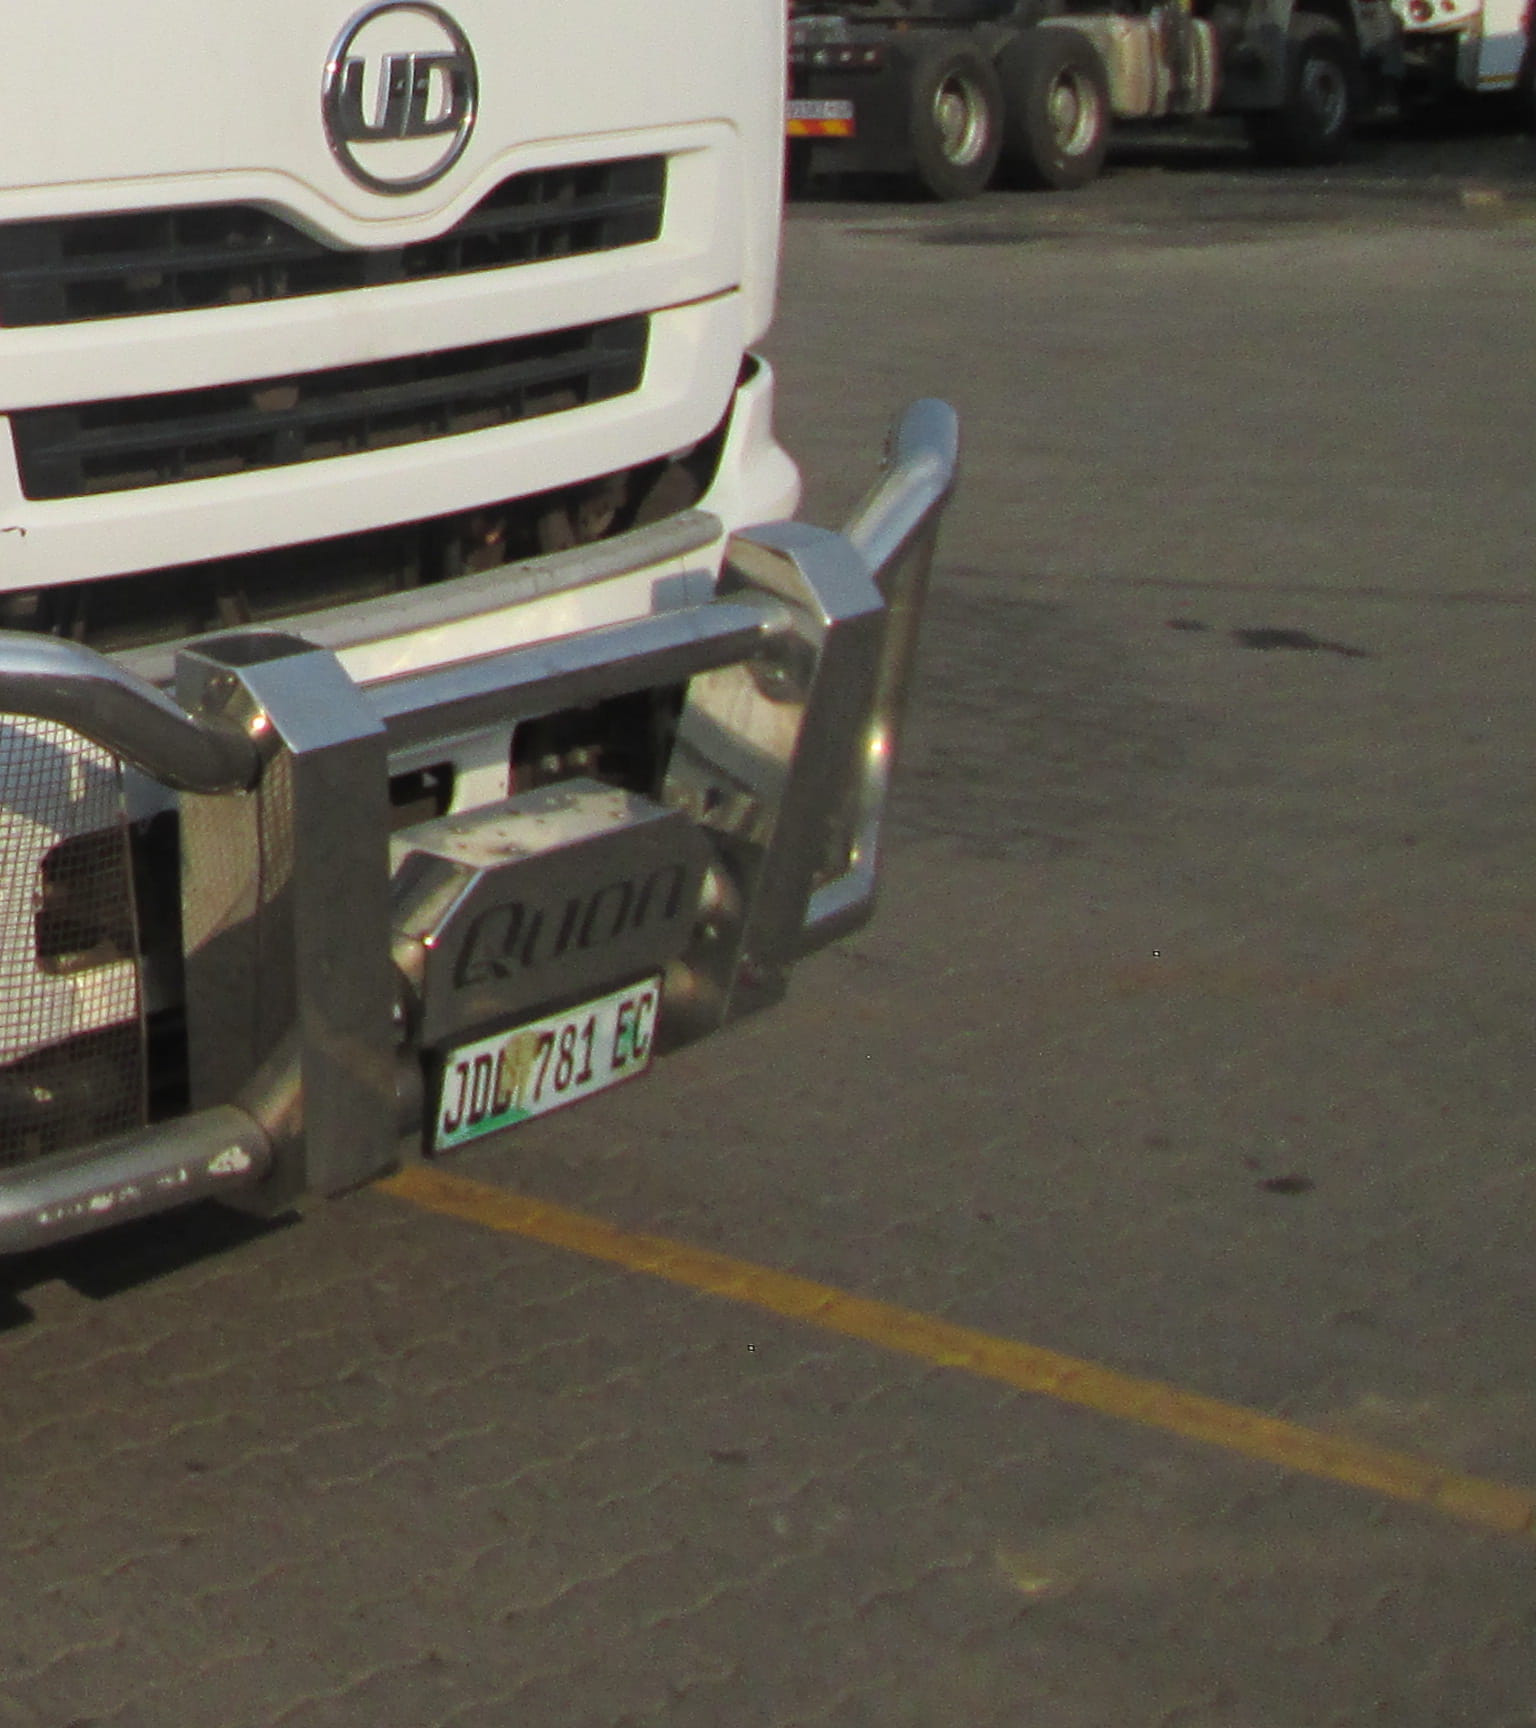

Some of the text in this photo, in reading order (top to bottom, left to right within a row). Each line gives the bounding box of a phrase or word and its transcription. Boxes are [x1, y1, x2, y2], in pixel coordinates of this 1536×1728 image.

[336, 52, 472, 142] UD
[443, 992, 653, 1134] JDL 781 EC
